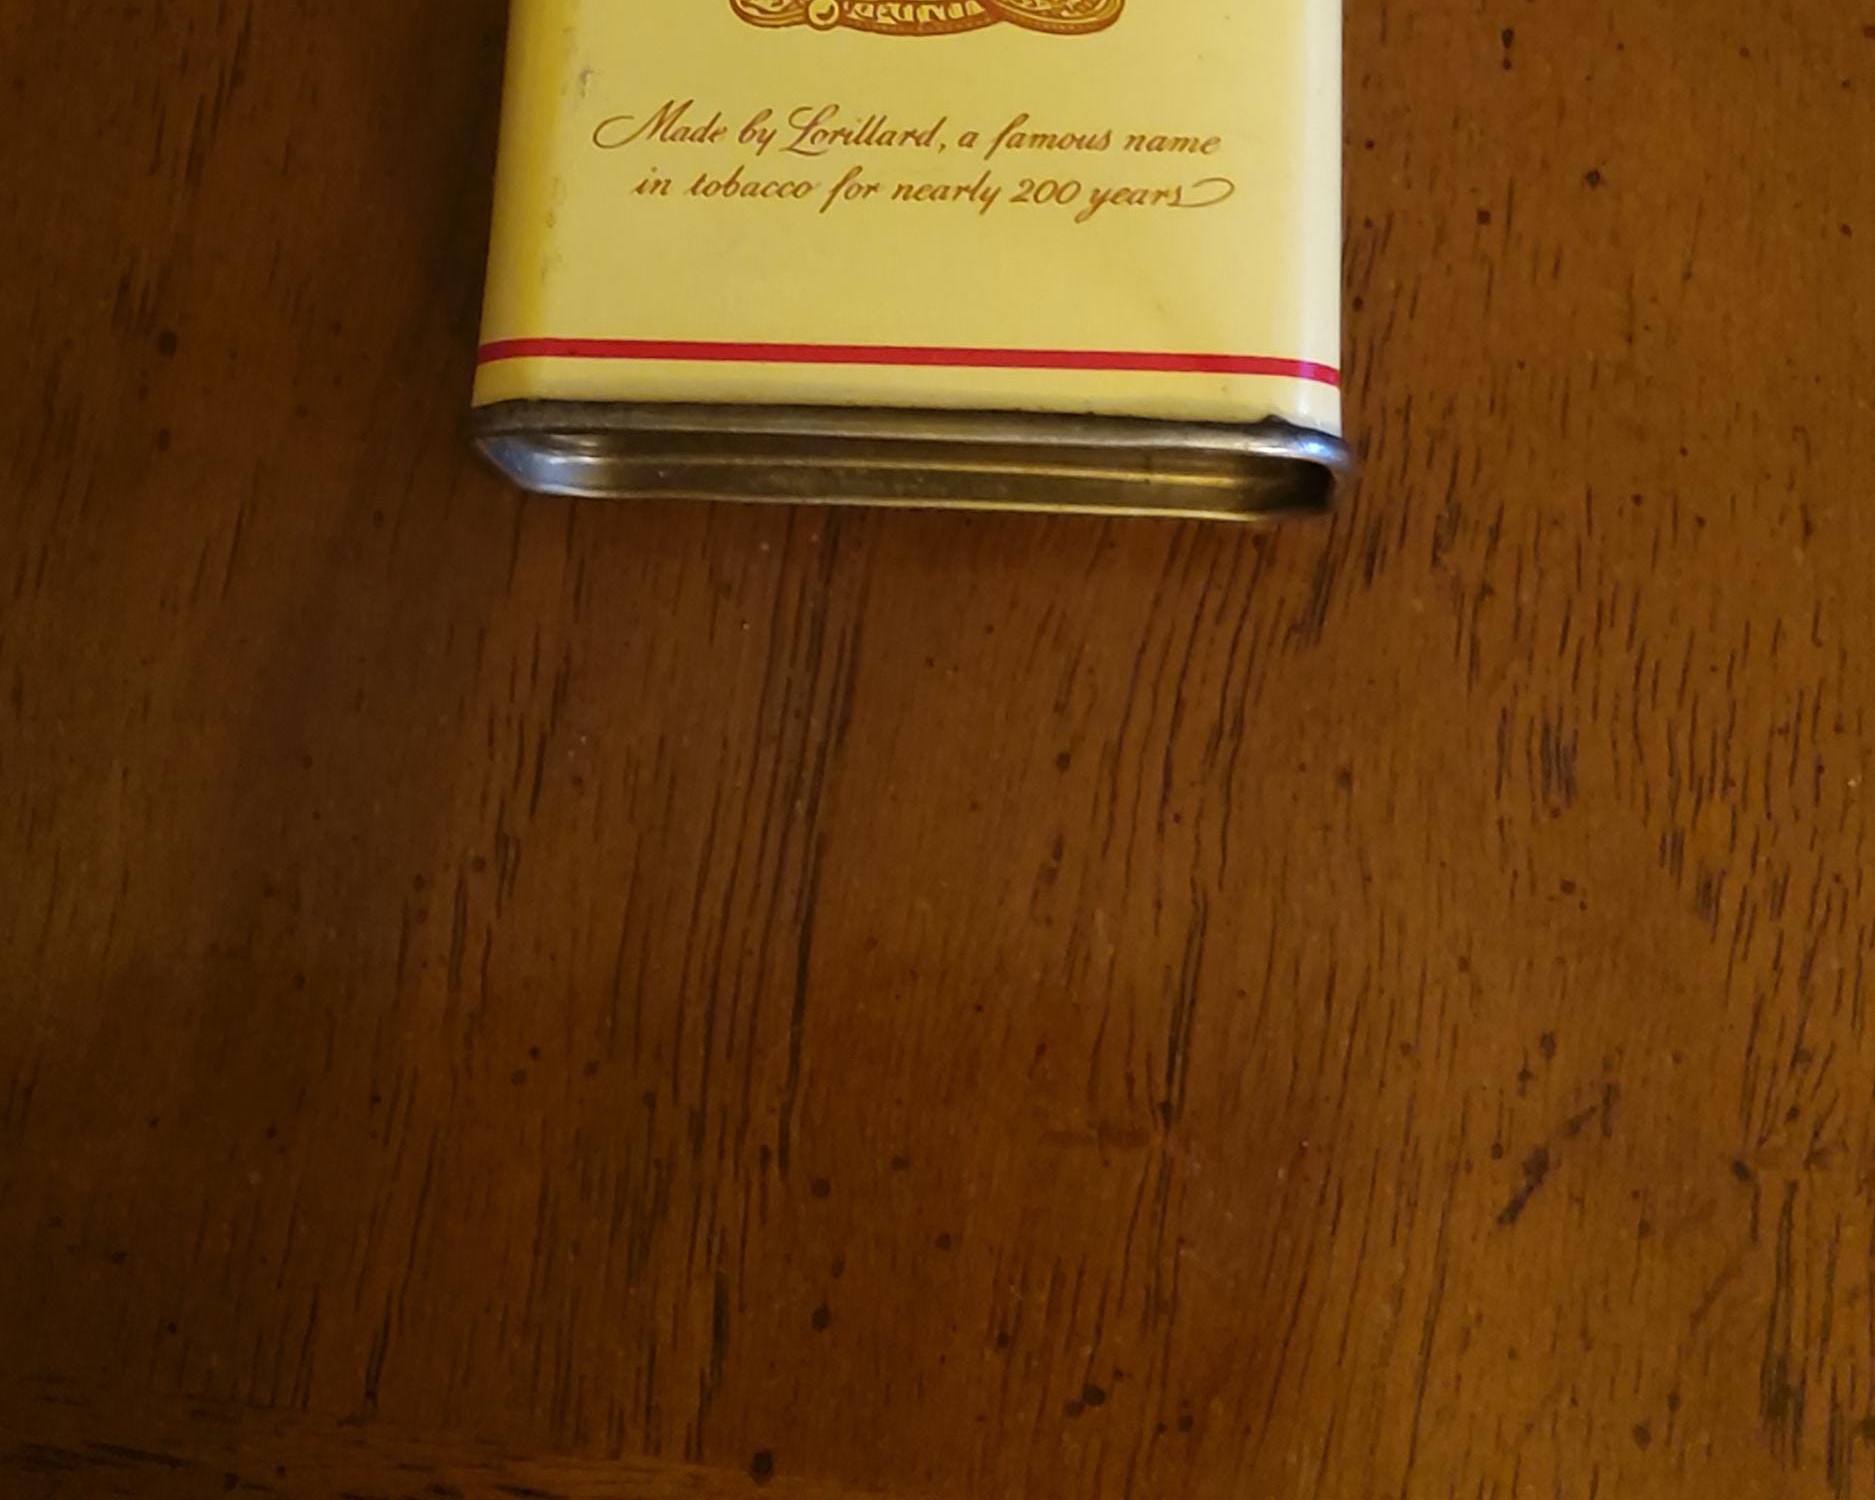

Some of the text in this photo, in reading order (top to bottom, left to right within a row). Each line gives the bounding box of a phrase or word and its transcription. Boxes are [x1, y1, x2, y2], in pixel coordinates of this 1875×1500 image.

[592, 99, 1220, 160] Made by Lorillard, a famous name
[631, 164, 1235, 223] in tobacco for nearly 200 years
